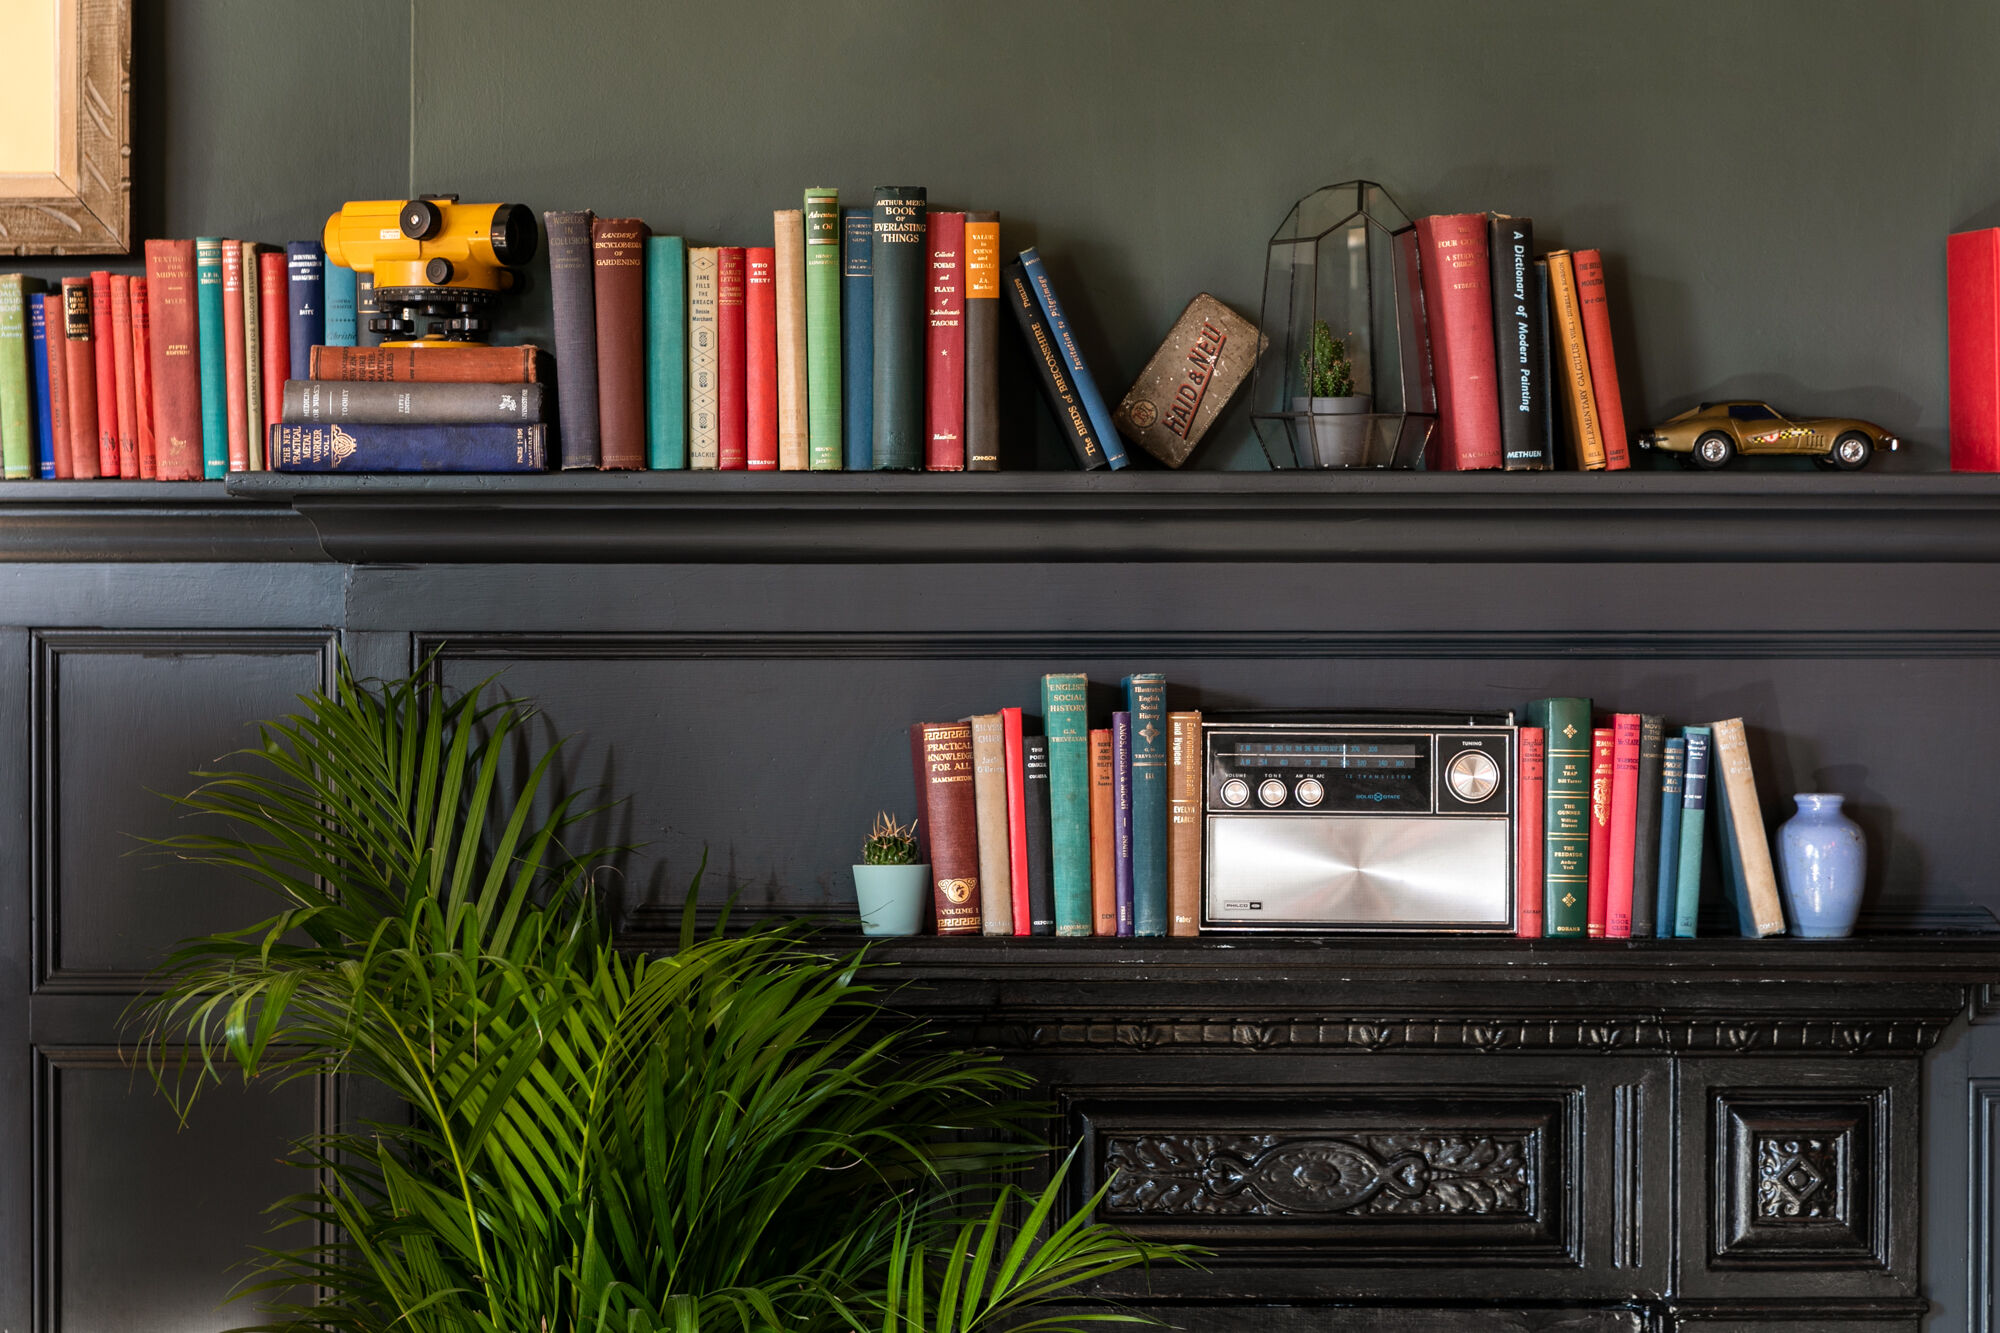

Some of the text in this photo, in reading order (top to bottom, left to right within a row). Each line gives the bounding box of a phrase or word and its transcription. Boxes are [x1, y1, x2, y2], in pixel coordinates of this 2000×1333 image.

[808, 211, 837, 219] Adventure
[885, 206, 916, 215] BOOK
[553, 216, 585, 224] WORLDS
[564, 226, 573, 234] IN
[822, 222, 833, 230] Oil
[874, 223, 926, 232] EVERLASTING
[551, 237, 590, 245] COLLISION
[881, 233, 920, 243] THINGS
[1438, 240, 1457, 248] FOUR
[941, 298, 949, 306] of
[1037, 275, 1083, 371] Invitation to Pilgrimage
[1513, 231, 1531, 413] A Dictionary of Modern Painting
[367, 351, 375, 382] MATHE-
[377, 348, 385, 382] MATICAL
[1161, 321, 1222, 437] HAID & NEU
[1031, 322, 1096, 456] The BIRDS of BRECONSHIRE
[1572, 342, 1596, 446] ELEMENTARY CALCULUS
[312, 406, 320, 421] FOR
[283, 427, 291, 463] THE NEW
[292, 426, 301, 464] PRACTICAL
[303, 429, 311, 459] METAL-
[313, 428, 322, 463] WORKER
[1462, 451, 1500, 459] MACMILLAN
[1507, 450, 1542, 458] METHUEN
[1053, 694, 1083, 702] SOCIAL
[1138, 695, 1160, 703] English
[1138, 712, 1160, 720] History
[975, 723, 1002, 732] SILVER
[977, 735, 1001, 743] CHIEF
[1119, 723, 1128, 748] AMOS,
[927, 742, 973, 752] PRACTICAL
[1173, 722, 1183, 766] and Hygiene
[1119, 749, 1128, 775] HOSEA
[1186, 722, 1195, 796] Environmental Health
[932, 762, 971, 772] FOR ALL
[932, 775, 973, 783] HAMMERTON
[1120, 784, 1128, 810] MICAH
[1173, 805, 1195, 814] EVELYN
[1173, 815, 1195, 823] PEARCE
[941, 907, 973, 915] VOLUME
[1175, 915, 1192, 923] Faber
